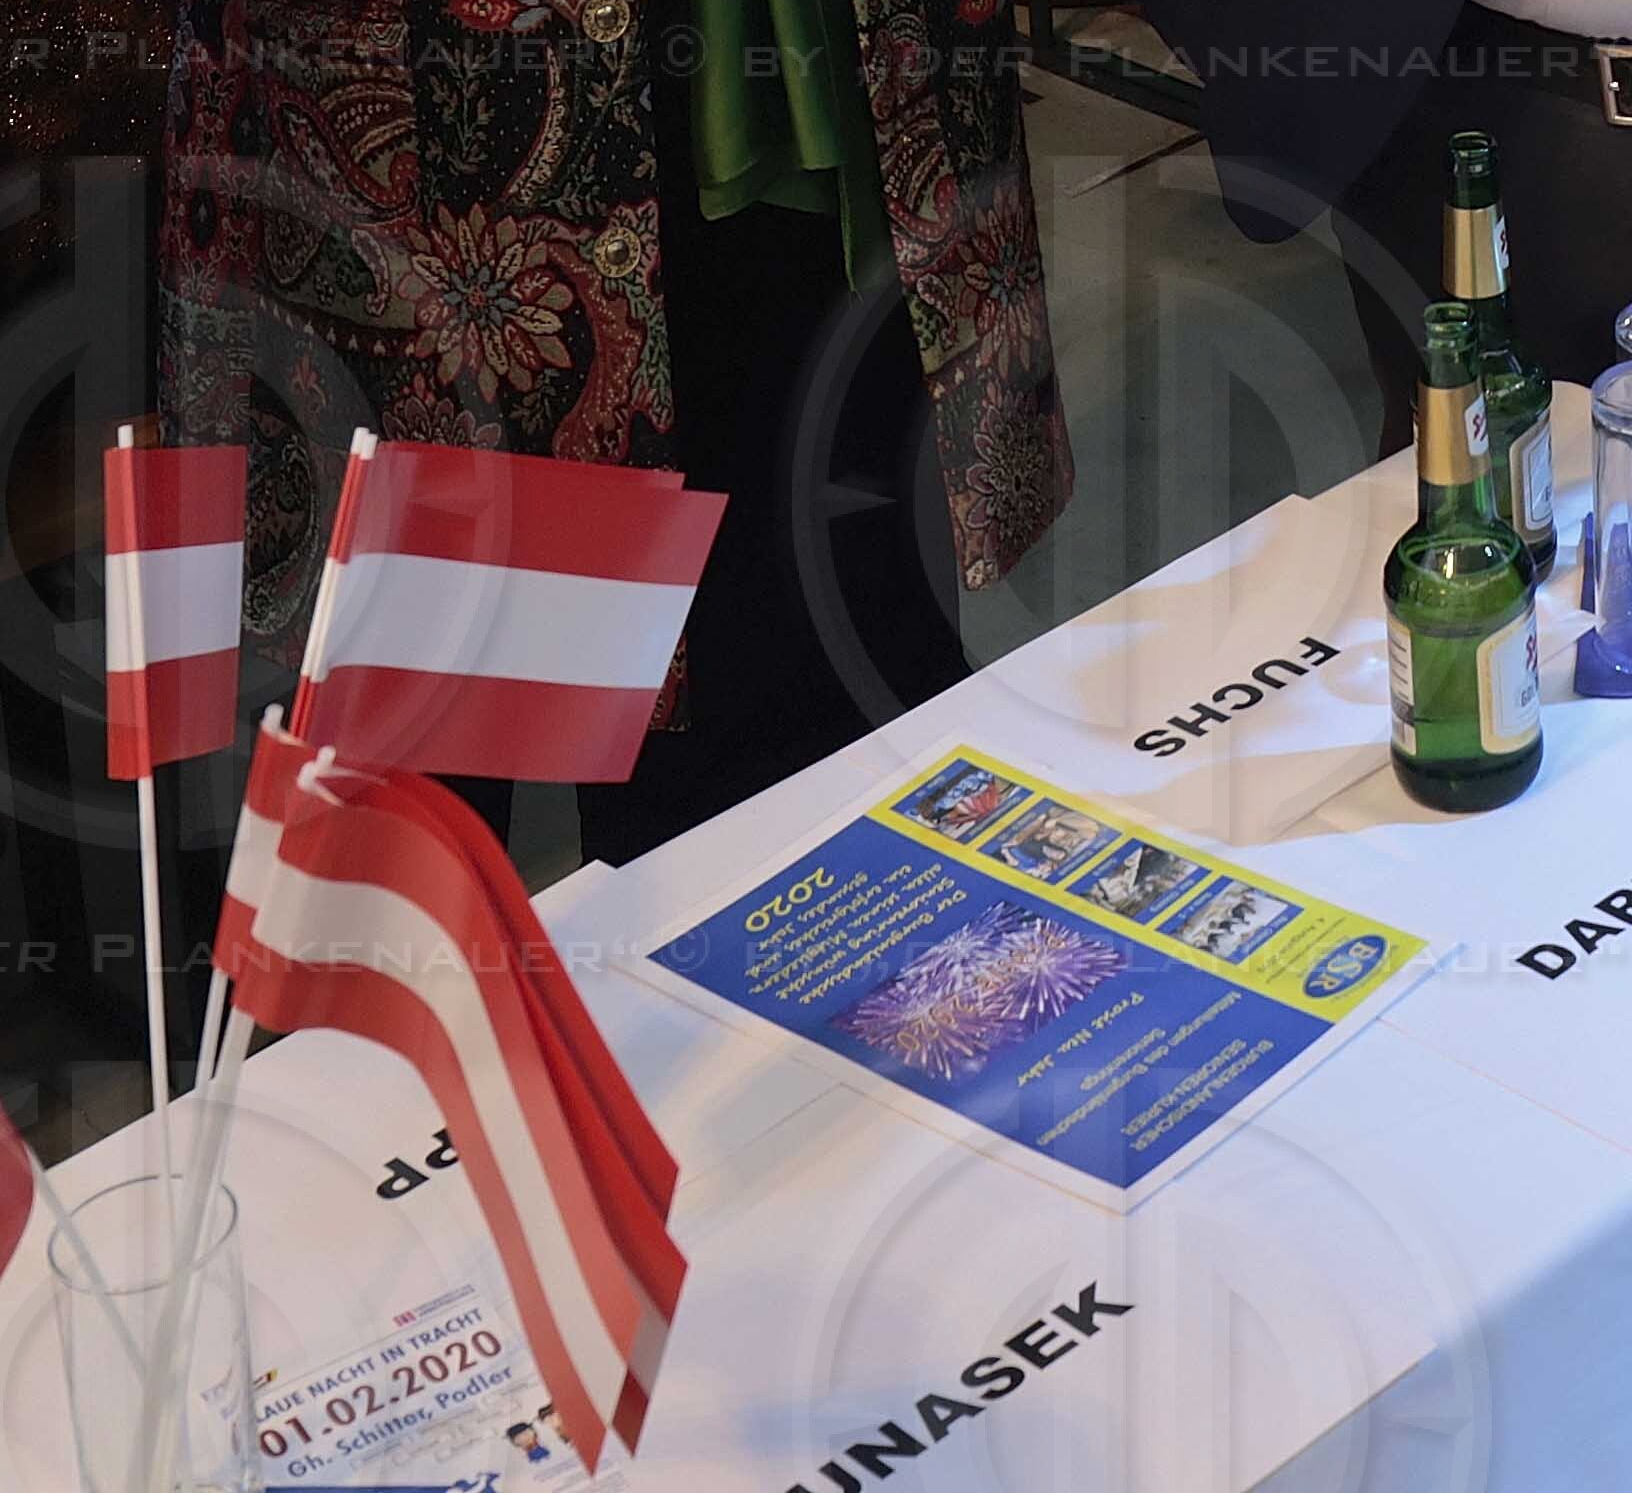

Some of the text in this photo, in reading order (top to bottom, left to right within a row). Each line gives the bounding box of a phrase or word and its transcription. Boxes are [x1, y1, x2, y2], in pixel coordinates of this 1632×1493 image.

[1132, 635, 1342, 761] FUCHS
[745, 867, 834, 931] 2020
[882, 864, 912, 883] ein
[900, 863, 941, 891] allen
[936, 889, 967, 912] Der
[758, 871, 867, 951] gesundes Jahr
[846, 891, 900, 927] seinen
[847, 876, 954, 949] Seniorenring
[1299, 939, 1385, 996] BSR
[1090, 991, 1144, 1029] Prosit
[1017, 1054, 1054, 1087] Jahr
[307, 1356, 376, 1398] NACHT
[379, 1343, 404, 1366] IN
[407, 1307, 483, 1349] TRACHT
[258, 1329, 502, 1459] 01.02.2020
[287, 1454, 334, 1479] Gh.
[434, 1365, 514, 1411] Podler
